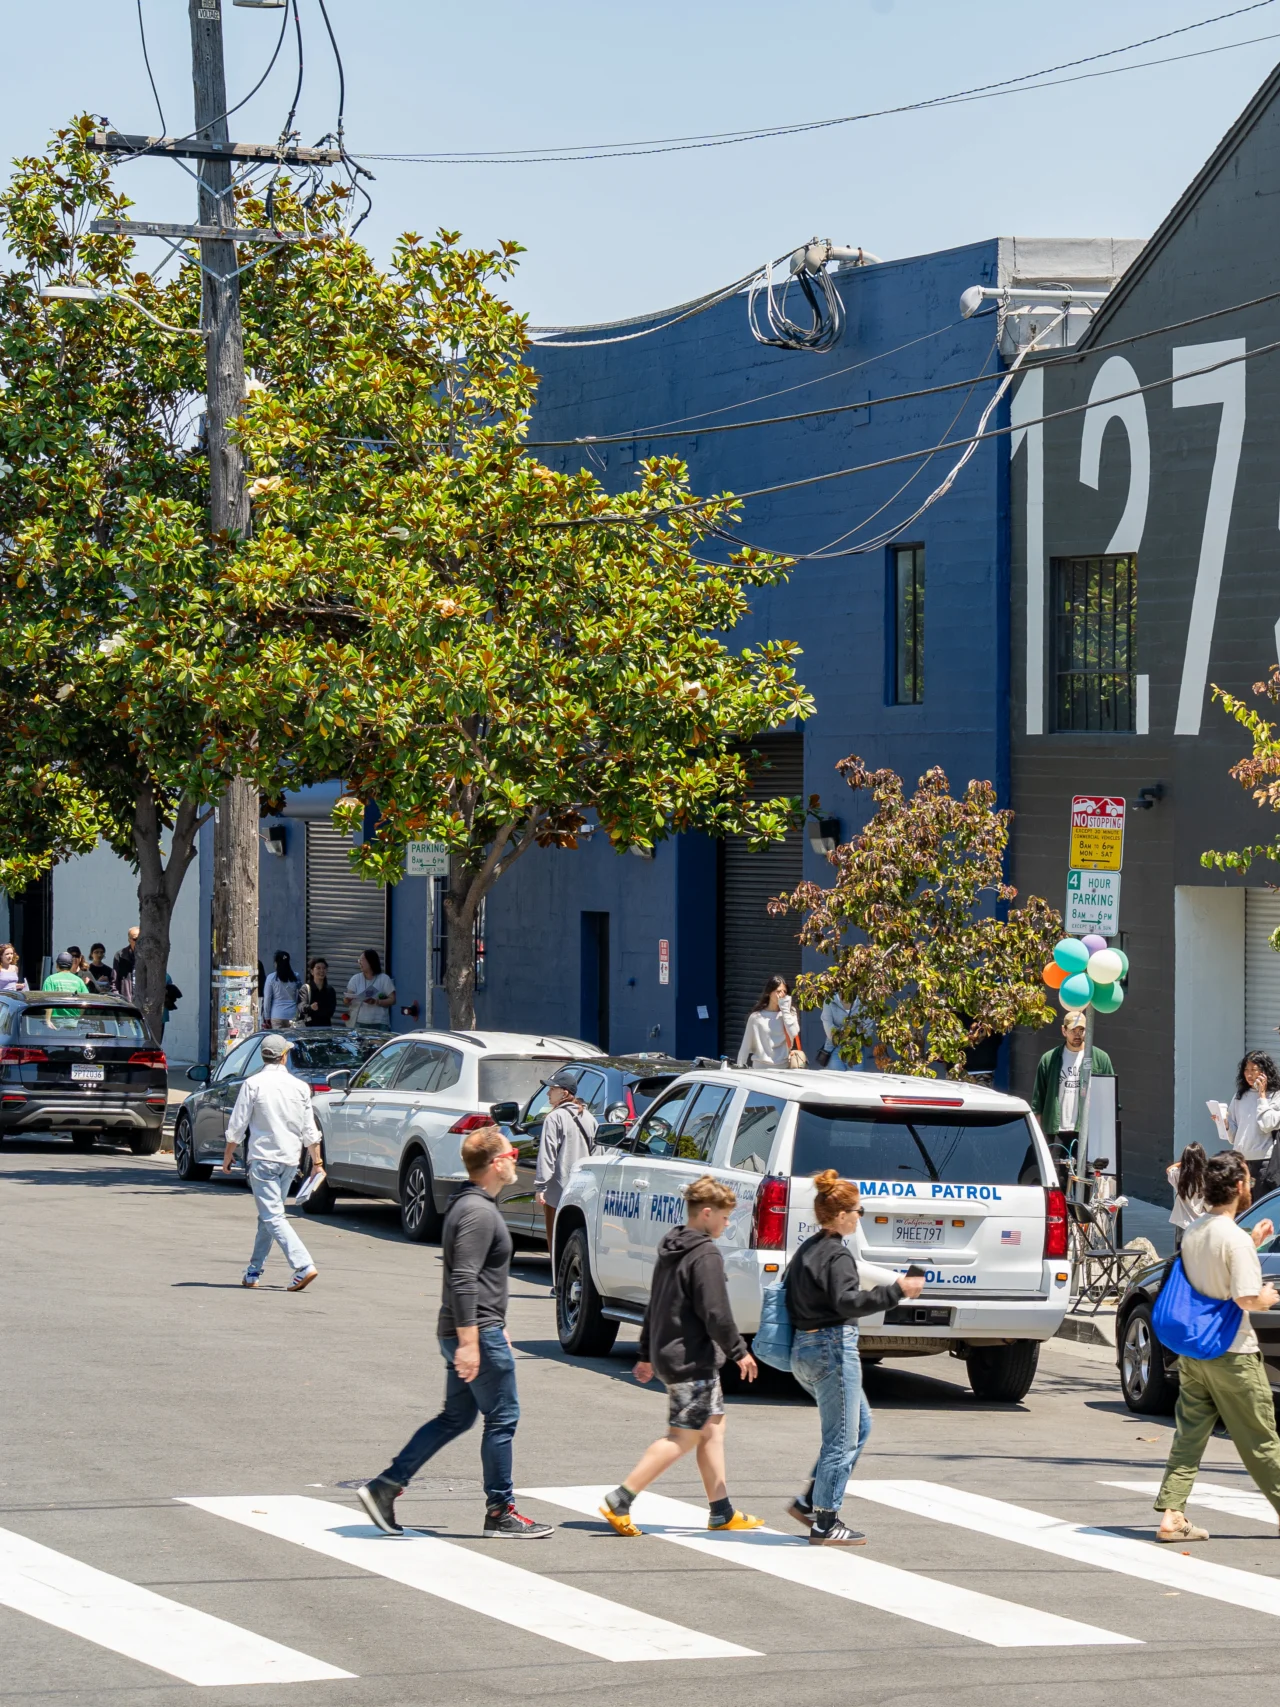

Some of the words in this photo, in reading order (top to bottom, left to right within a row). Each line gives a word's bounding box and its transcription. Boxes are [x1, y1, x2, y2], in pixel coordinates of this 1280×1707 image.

[1073, 813, 1088, 827] NO
[1089, 816, 1122, 829] STOPPING
[411, 843, 445, 853] PARKING
[1069, 873, 1079, 888] 4
[1088, 878, 1111, 889] HOUR
[1072, 893, 1113, 907] PARKING
[860, 1181, 917, 1197] MADA
[932, 1184, 1002, 1200] PATROL
[603, 1189, 640, 1219] ARMADA
[798, 1222, 822, 1233] Priv
[904, 1219, 933, 1227] California
[896, 1226, 942, 1241] 9HEE797
